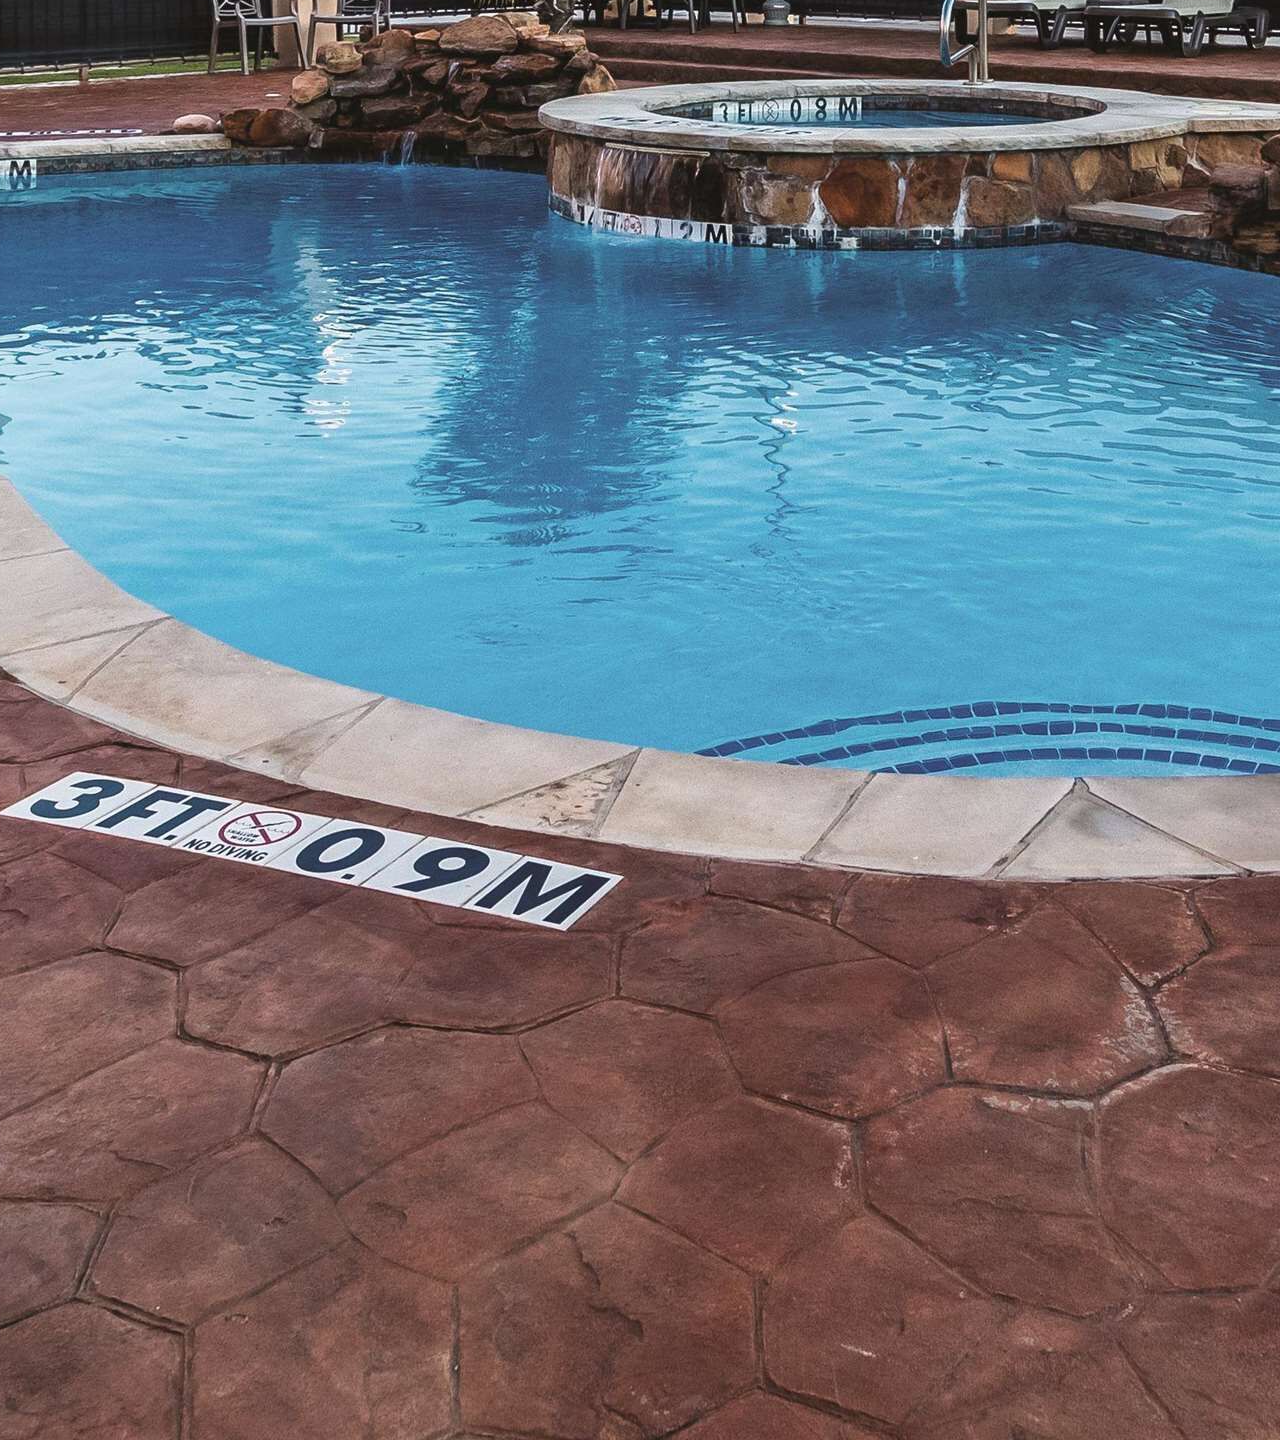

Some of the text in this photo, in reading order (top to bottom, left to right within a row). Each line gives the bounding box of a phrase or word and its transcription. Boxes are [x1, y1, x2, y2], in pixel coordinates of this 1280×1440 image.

[704, 223, 728, 245] M
[227, 829, 260, 839] SHALLOW
[230, 834, 256, 843] WATER
[30, 779, 124, 818] 3
[95, 789, 232, 840] FT.
[474, 861, 611, 924] M
[183, 838, 269, 862] NO DIVING
